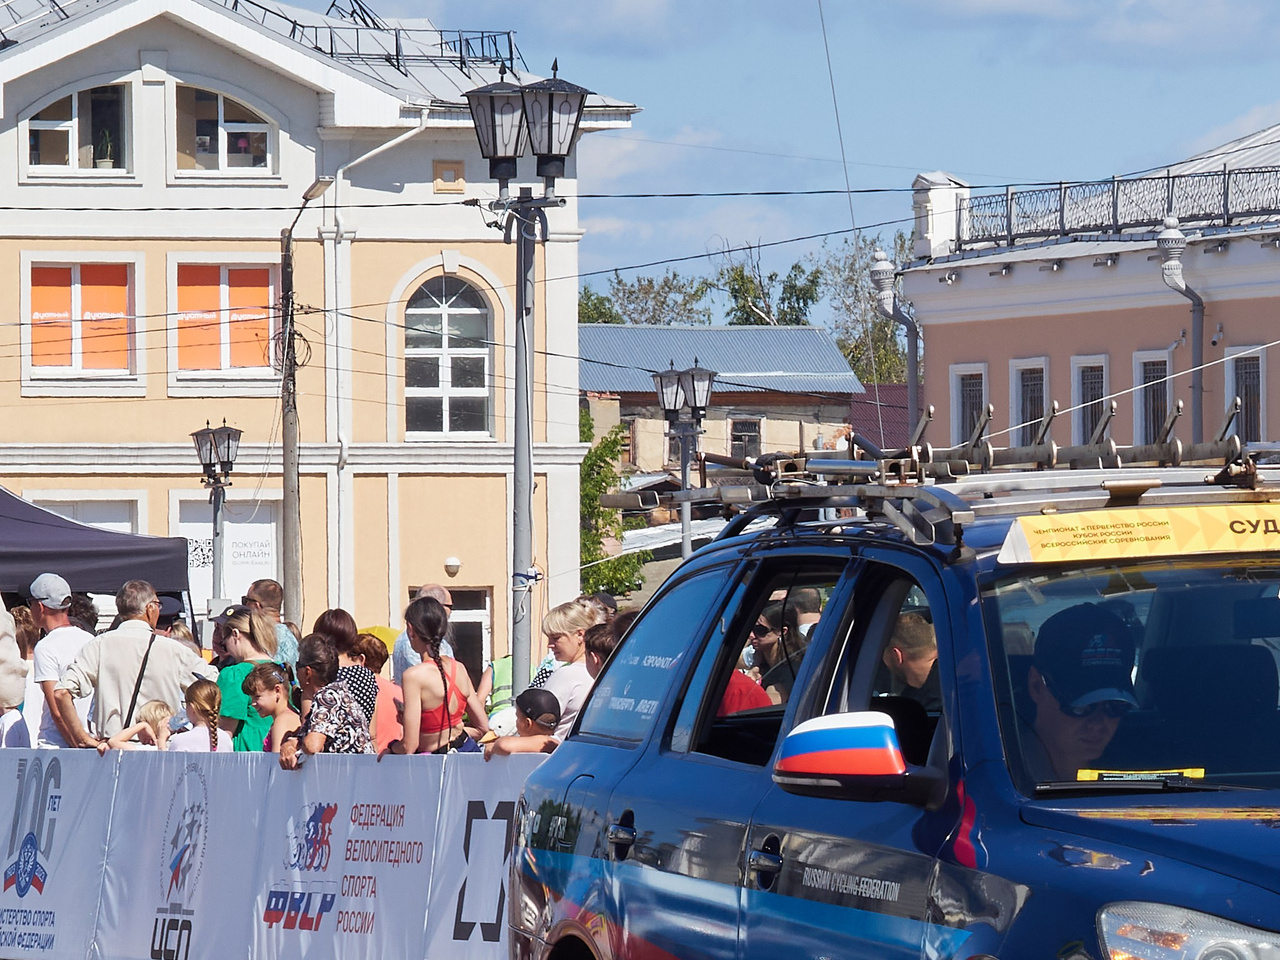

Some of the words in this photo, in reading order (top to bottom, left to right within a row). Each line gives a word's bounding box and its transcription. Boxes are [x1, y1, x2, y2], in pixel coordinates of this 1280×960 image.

[1033, 526, 1079, 535] ЧЕМПИОНАТ
[1087, 522, 1135, 531] ПЕРВЕНСТВО
[231, 540, 271, 548] ПОКУПАЙ
[1041, 538, 1107, 549] ВСЕРОССИЙСКИЕ
[1109, 534, 1171, 544] СОРЕВНОВАНИЯ
[231, 549, 270, 559] ОНЛАЙН
[641, 655, 673, 669] АЭРОФЛОТ
[47, 794, 62, 812] ЛЕТ
[350, 803, 405, 831] ФЕДЕРАЦИЯ
[345, 839, 423, 868] ВЕЛОСИПЕДНОГО
[341, 875, 376, 898] СПОРТА
[802, 867, 830, 890] RUSSIAN
[830, 873, 859, 895] CYCLING
[859, 877, 900, 902] FEDERATION
[32, 910, 55, 927] СПОРТА
[336, 911, 375, 934] РОССИИ
[0, 926, 17, 947] СКОЙ
[17, 931, 55, 952] ФЕДЕРАЦИИ
